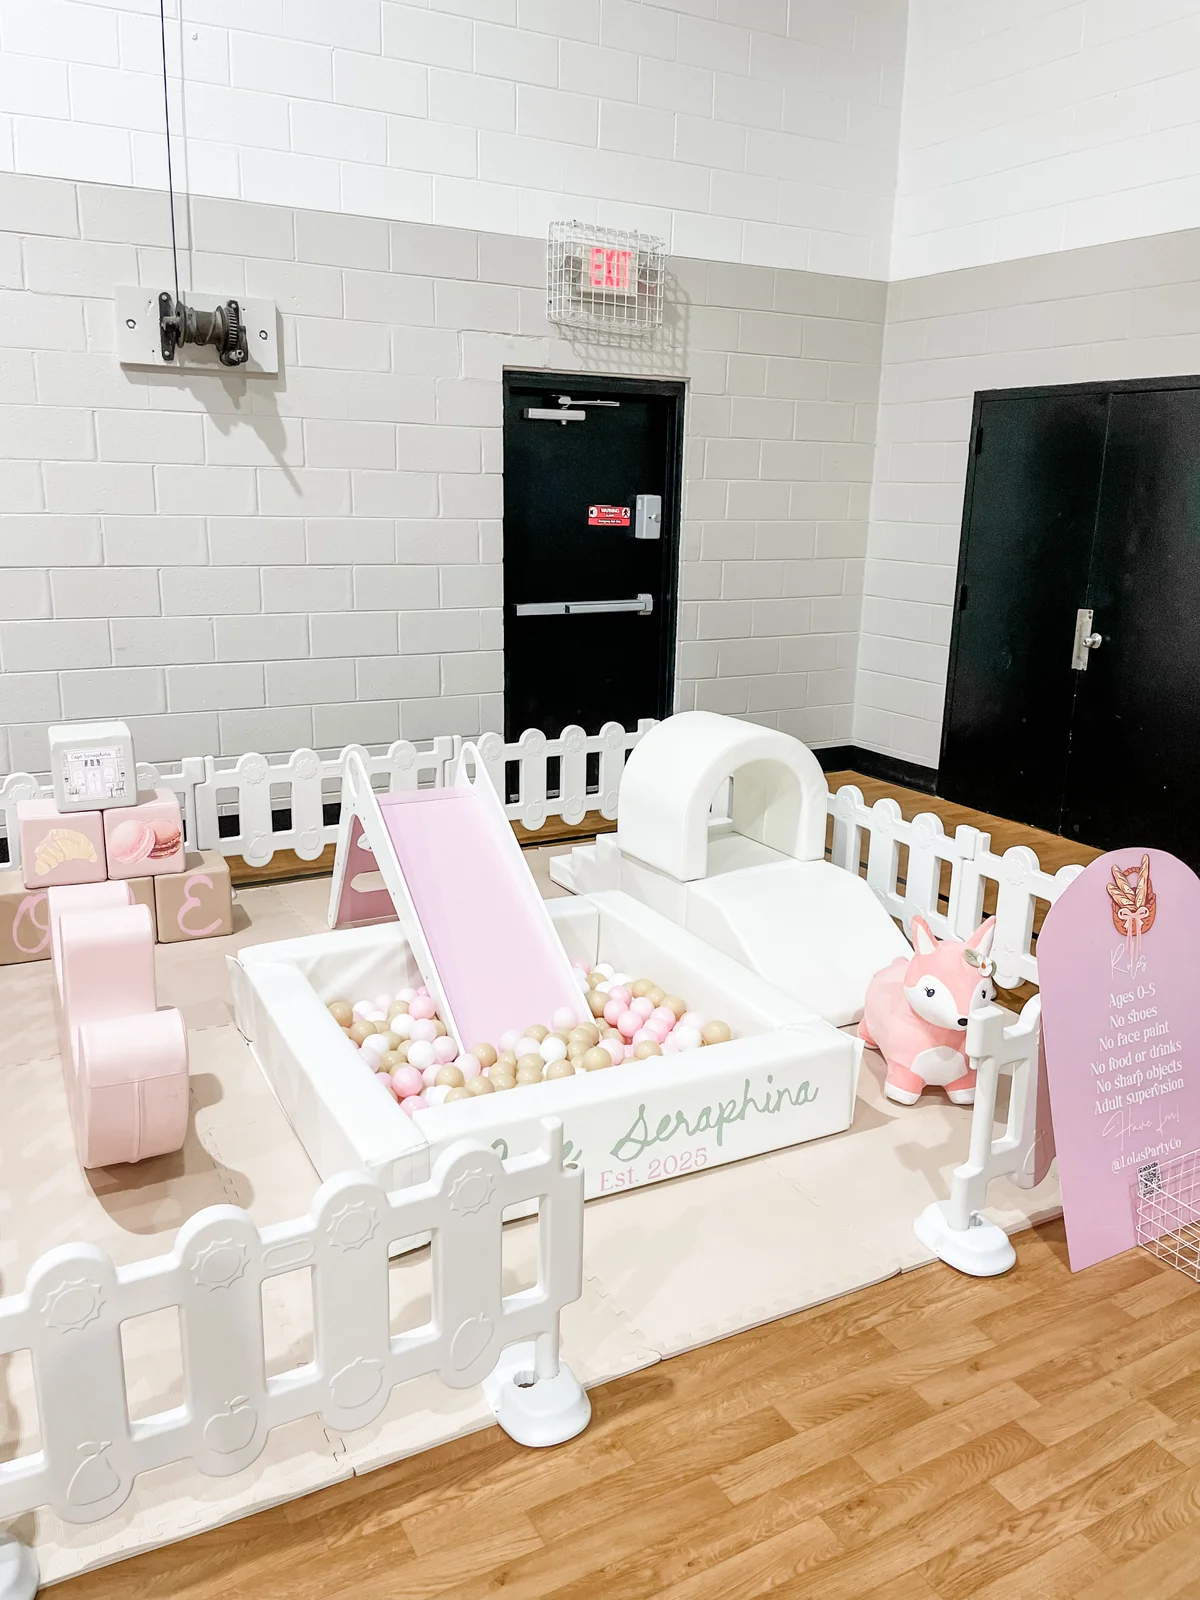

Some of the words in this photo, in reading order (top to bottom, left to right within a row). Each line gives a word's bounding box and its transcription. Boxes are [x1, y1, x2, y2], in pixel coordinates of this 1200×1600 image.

[590, 247, 632, 289] EXIT
[1109, 991, 1135, 1009] Ages
[1137, 982, 1156, 999] 0-5
[1099, 1036, 1114, 1052] No
[1117, 1031, 1141, 1047] face
[1143, 1020, 1170, 1043] paint
[1110, 1014, 1125, 1030] No
[1127, 1006, 1158, 1024] shoes
[1090, 1061, 1106, 1077] No
[1108, 1052, 1132, 1072] food
[1135, 1050, 1147, 1063] or
[1150, 1040, 1182, 1059] drinks
[1096, 1079, 1112, 1095] No
[1114, 1069, 1144, 1089] sharp
[1146, 1059, 1183, 1081] objects
[1094, 1094, 1123, 1116] Adult
[1126, 1077, 1184, 1105] supervision
[610, 1074, 819, 1163] Seraphina
[1102, 1107, 1152, 1151] Have
[1155, 1103, 1180, 1137] fun!
[600, 1167, 640, 1192] Est.
[647, 1147, 708, 1179] 2025
[1111, 1137, 1182, 1174] @LolasPartyCo
